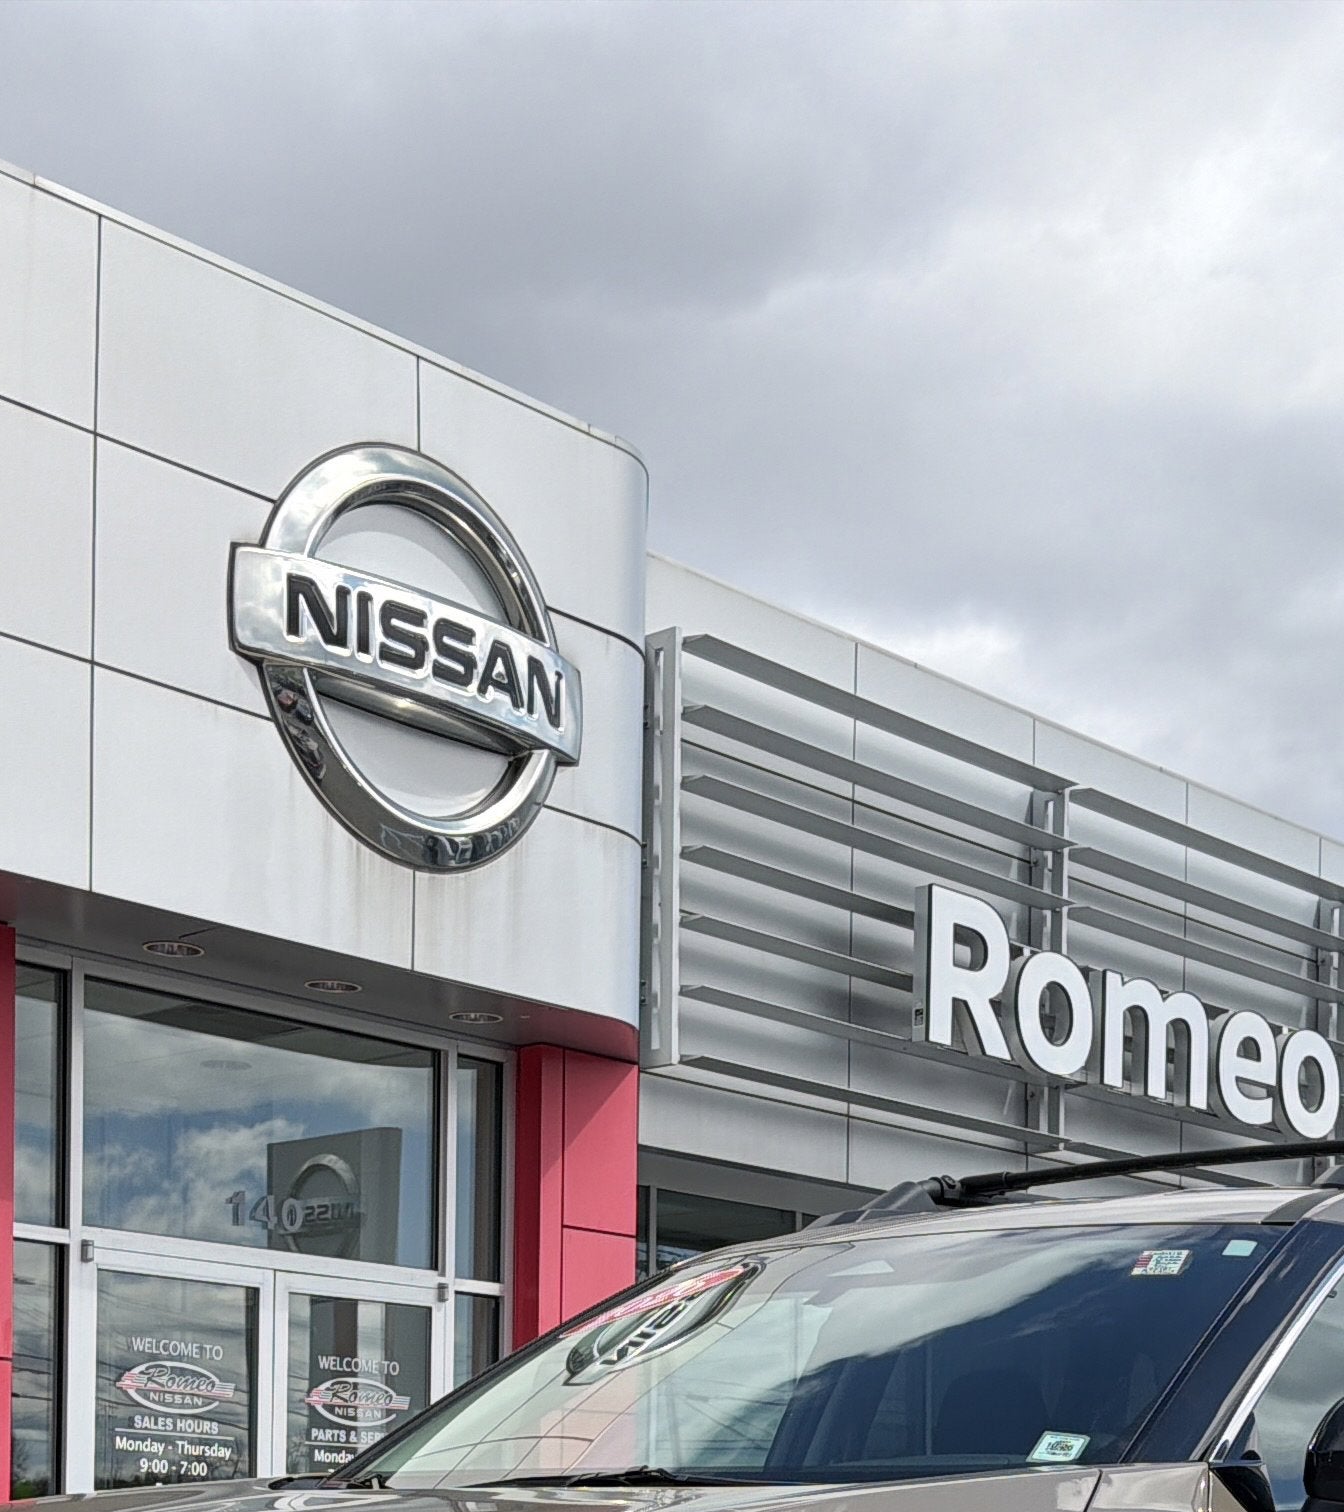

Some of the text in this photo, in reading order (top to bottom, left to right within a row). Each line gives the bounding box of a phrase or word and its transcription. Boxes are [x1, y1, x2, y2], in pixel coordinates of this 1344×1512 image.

[284, 572, 566, 734] NISSAN
[920, 882, 1341, 1140] Romeo
[225, 1190, 305, 1232] 140
[131, 1336, 224, 1360] WELCOME TO
[318, 1355, 400, 1376] WELCOME TO
[139, 1363, 216, 1393] Romeo
[149, 1392, 203, 1406] NISSAN
[326, 1380, 393, 1406] Romeo
[134, 1415, 219, 1434] SALES HOURS
[334, 1406, 382, 1419] NISSAN
[115, 1435, 165, 1456] Monday
[175, 1440, 232, 1460] Thursday
[311, 1428, 346, 1442] PARTS
[350, 1430, 357, 1443] &
[139, 1458, 169, 1474] 9:00
[180, 1461, 207, 1476] 7:00
